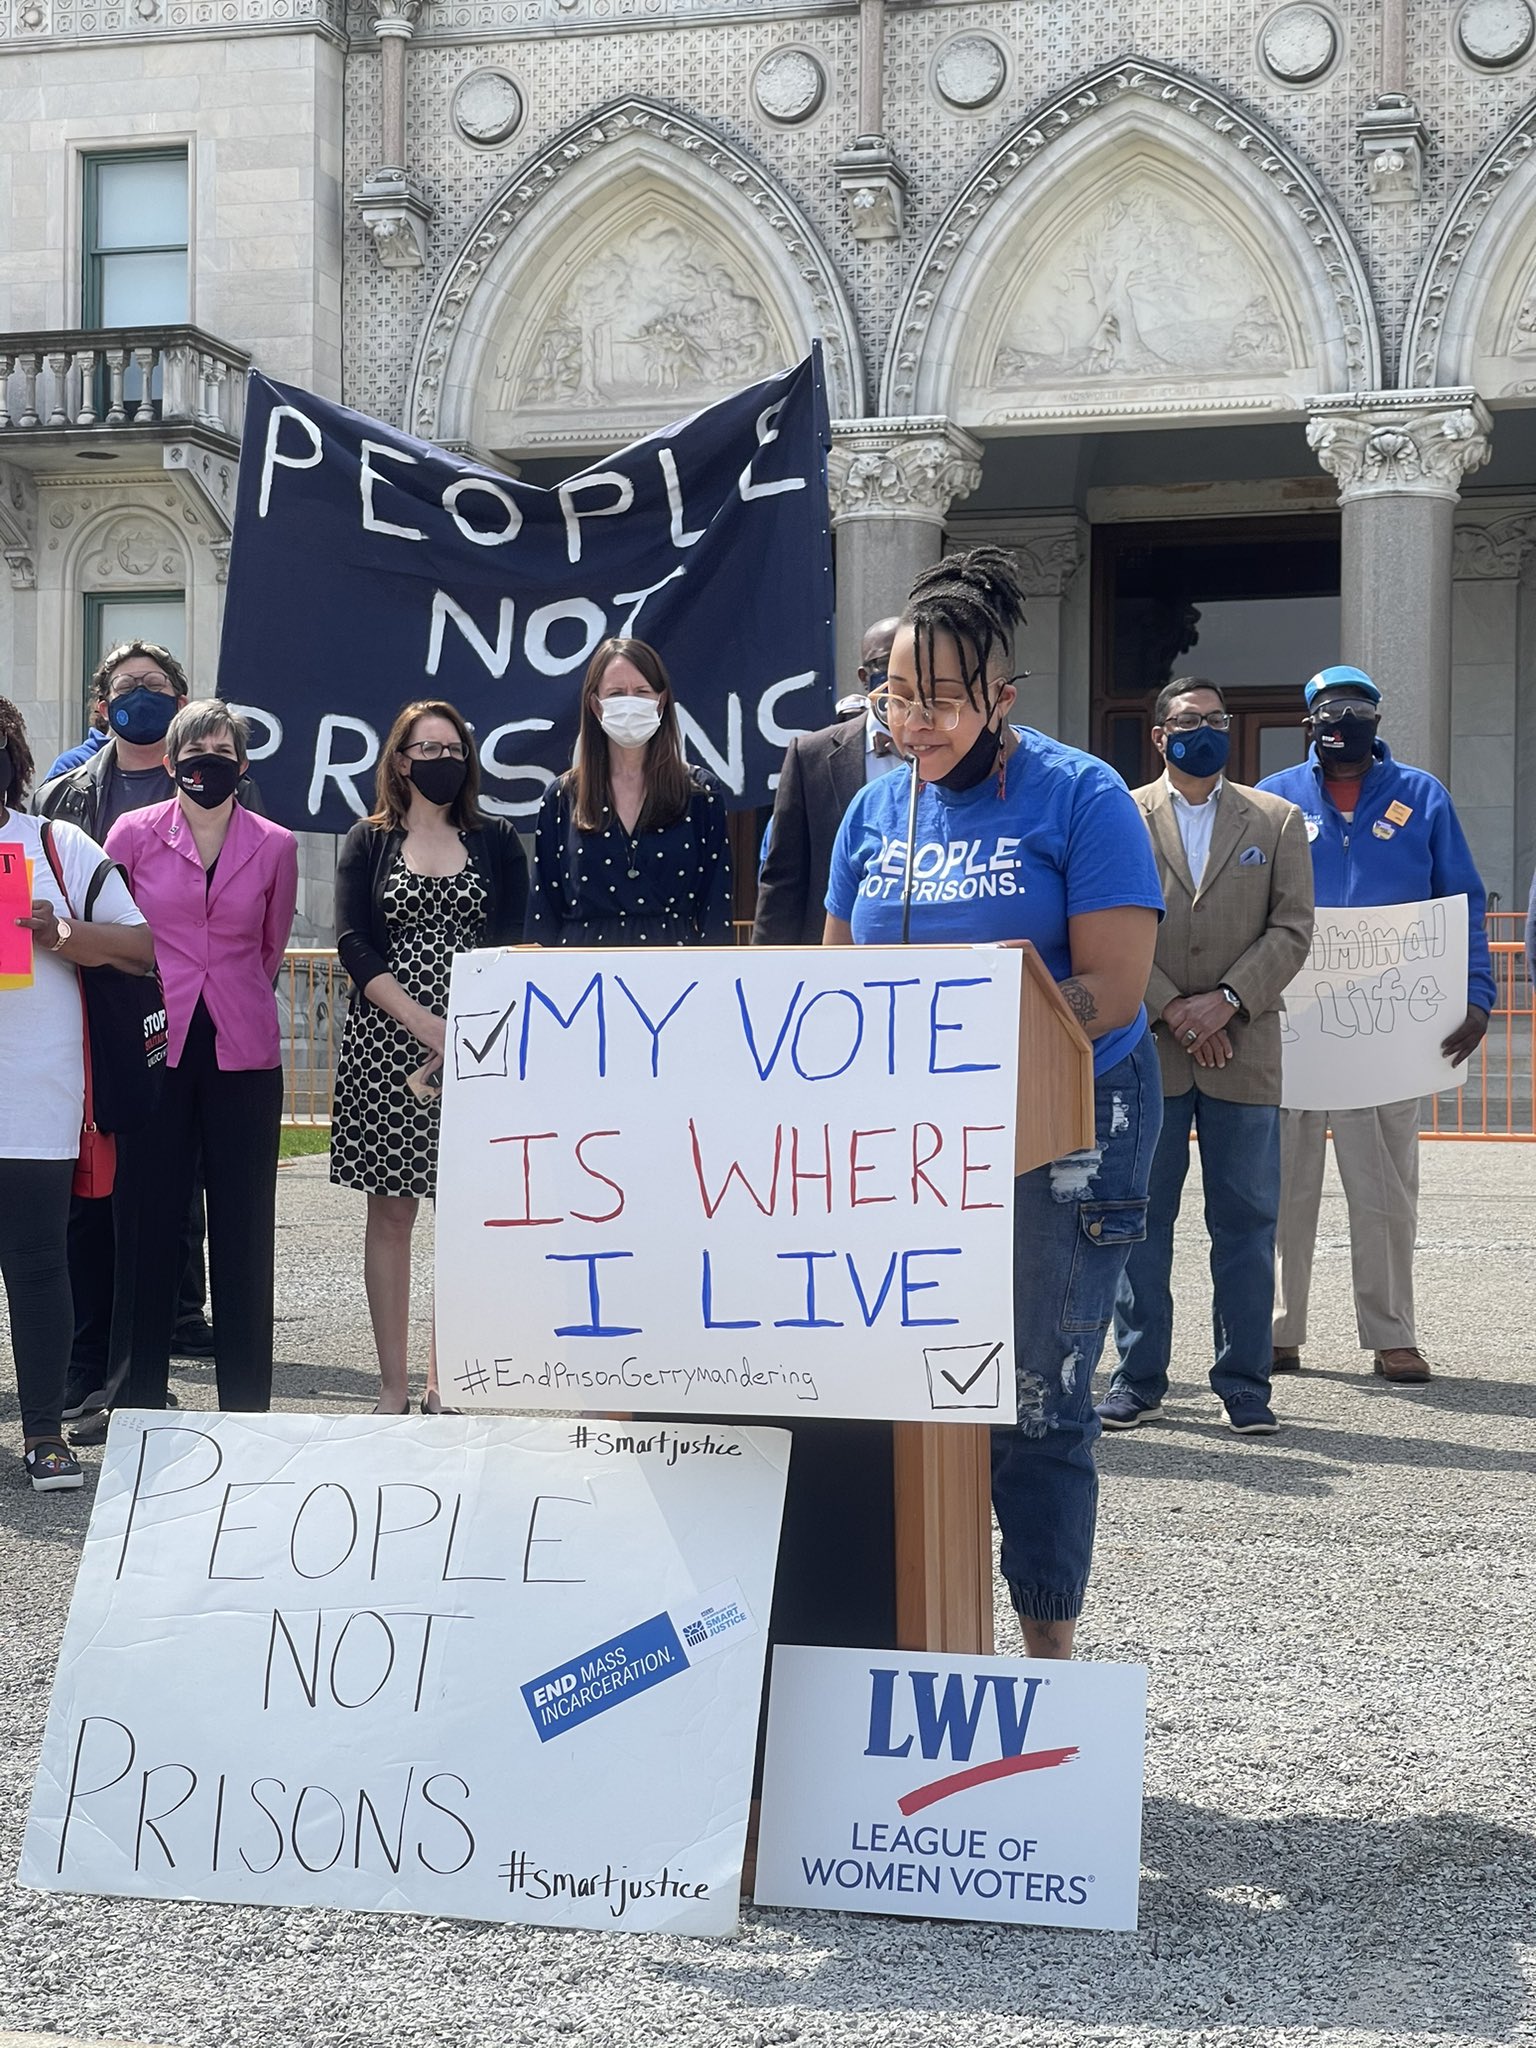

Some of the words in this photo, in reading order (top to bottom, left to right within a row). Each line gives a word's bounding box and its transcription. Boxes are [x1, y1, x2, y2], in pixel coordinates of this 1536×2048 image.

[259, 395, 808, 564] PEOPLE
[424, 564, 687, 679] NOT
[225, 670, 822, 816] PRSNS
[143, 1009, 166, 1038] STOP
[519, 972, 699, 1081] MY
[735, 977, 1001, 1082] VOTE
[1314, 966, 1447, 1039] Life
[483, 1130, 625, 1227] IS
[688, 1117, 1006, 1219] WHERE
[545, 1251, 643, 1337] I
[701, 1247, 963, 1328] LIVE
[115, 1426, 592, 1584] PEOPLE
[263, 1608, 474, 1713] NOT
[705, 1606, 738, 1629] SMART
[709, 1612, 747, 1637] JUSTICE
[533, 1673, 577, 1708] END
[580, 1647, 627, 1683] MASS
[541, 1646, 676, 1726] INCARCERATION.
[57, 1716, 476, 1875] PRISONS
[801, 1857, 940, 1895] WOMEN
[851, 1822, 987, 1859] LEAGUE
[999, 1838, 1038, 1862] OF
